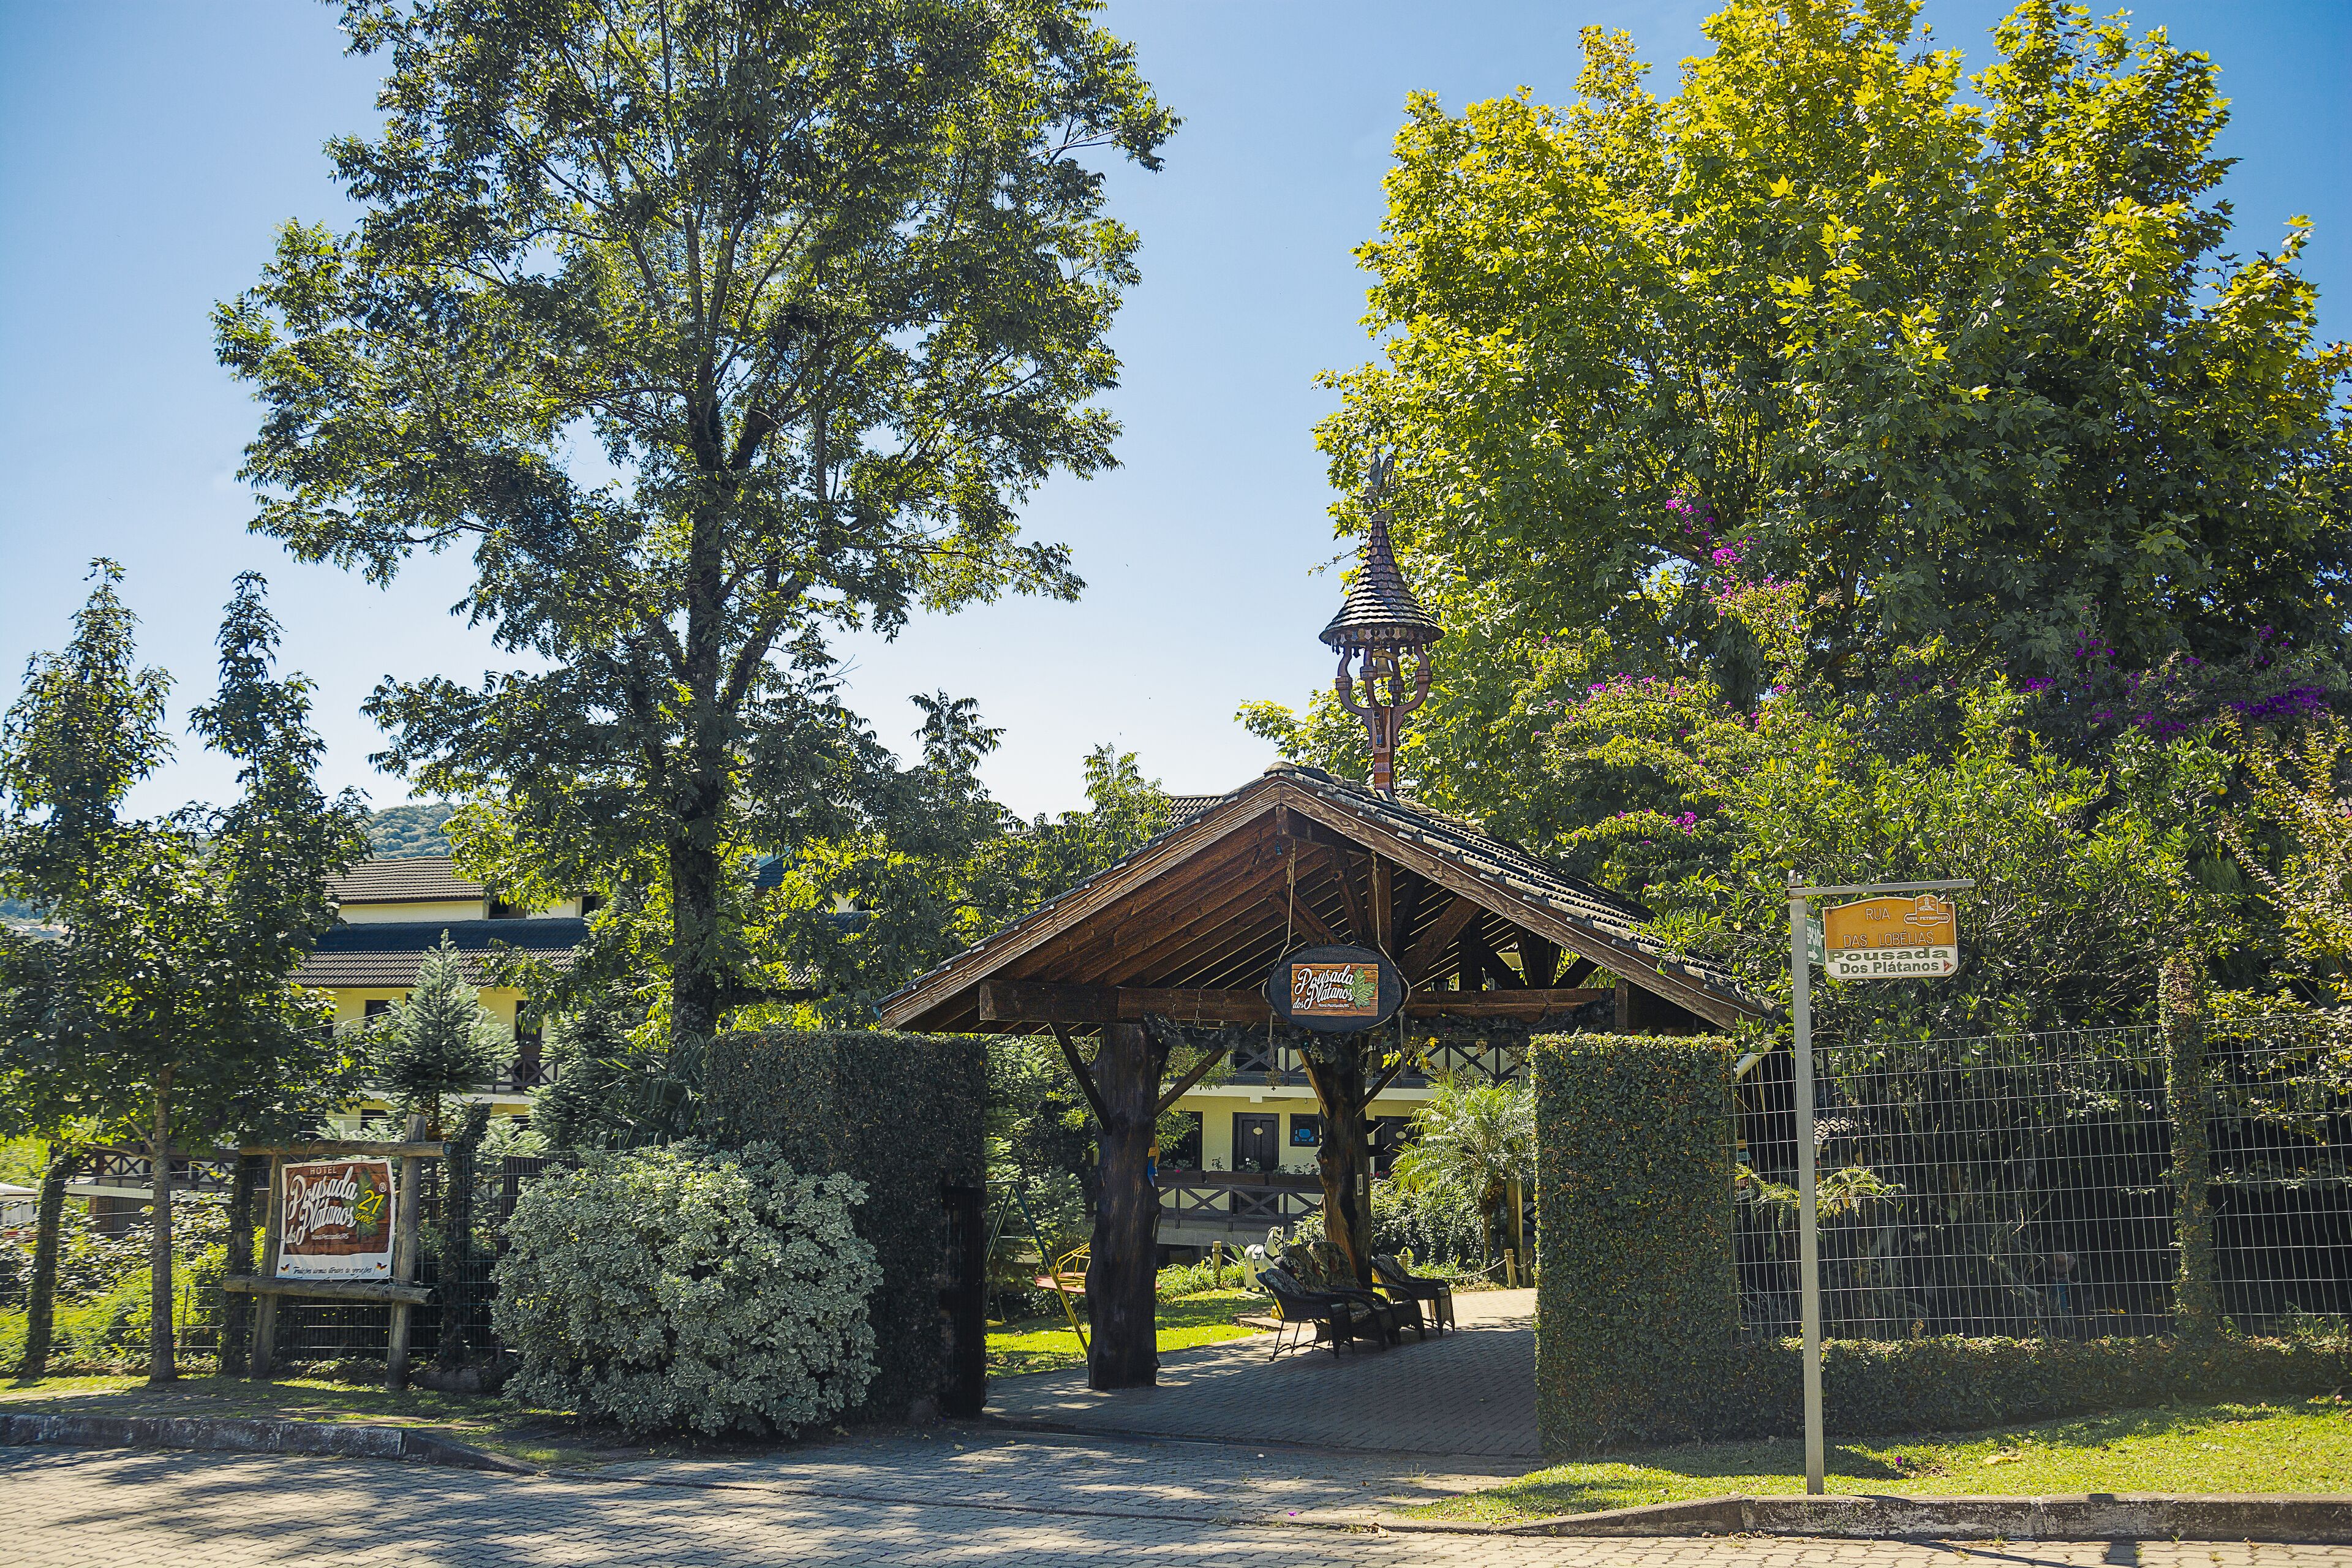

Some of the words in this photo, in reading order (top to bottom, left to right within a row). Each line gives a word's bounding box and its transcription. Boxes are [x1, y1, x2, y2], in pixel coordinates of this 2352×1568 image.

[1866, 908, 1890, 921] RUA
[1843, 935, 1868, 948] DAS
[1879, 929, 1934, 946] LOBÉLIAS
[1828, 948, 1950, 963] Pousada
[1840, 963, 1868, 974] Dos
[1873, 961, 1939, 973] Plátanos
[1294, 965, 1354, 995] Pousada
[1292, 997, 1304, 1009] dos
[1304, 982, 1355, 1009] Plátanos
[310, 1166, 337, 1175] HOTEL
[287, 1166, 358, 1220] Pousada
[357, 1189, 385, 1215] 21
[285, 1225, 296, 1244] dos
[296, 1197, 357, 1246] Plátanos
